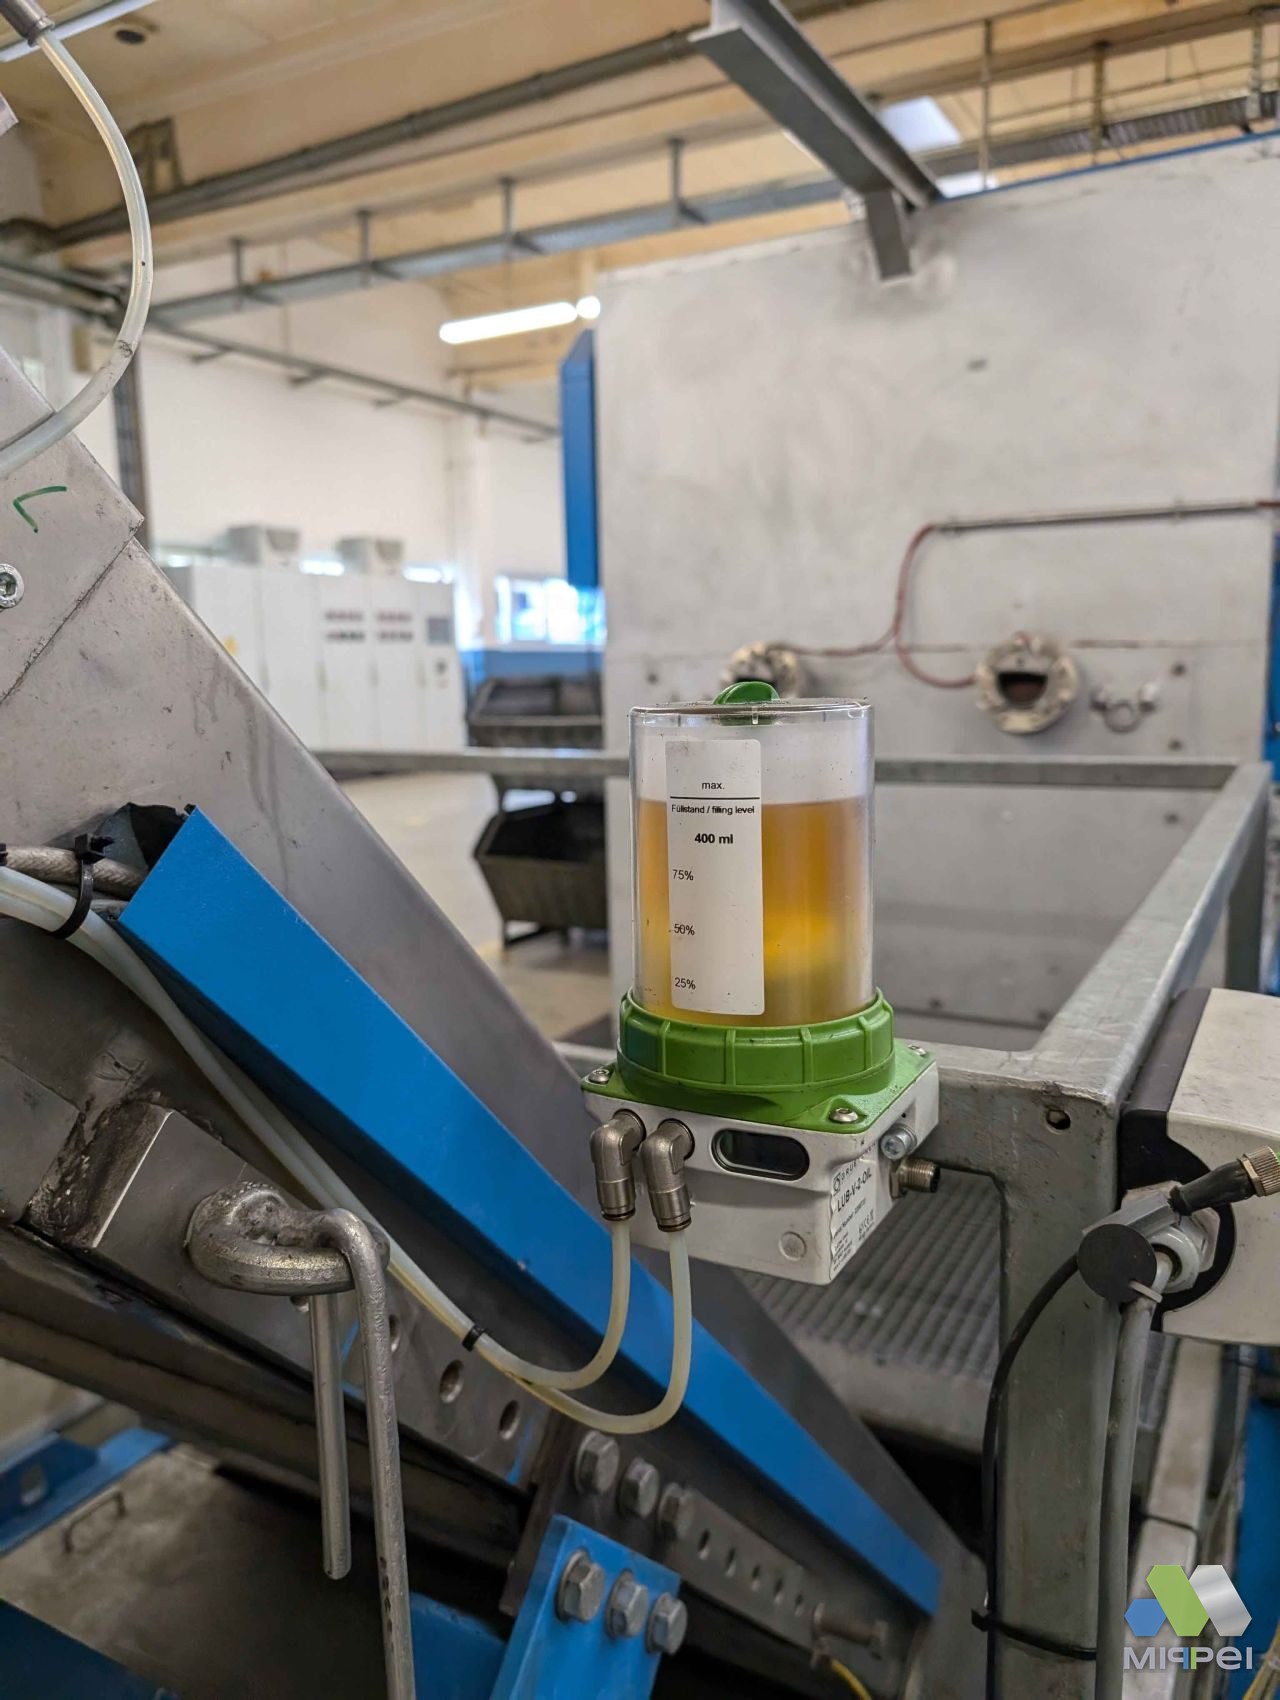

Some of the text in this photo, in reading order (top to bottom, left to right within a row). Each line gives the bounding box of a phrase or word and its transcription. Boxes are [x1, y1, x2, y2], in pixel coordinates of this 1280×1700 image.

[701, 782, 725, 790] max.
[671, 804, 755, 816] Füllstand / filling level
[694, 833, 734, 844] 400 ml
[672, 869, 694, 881] 75%
[673, 923, 695, 936] 50%
[674, 976, 696, 990] 25%
